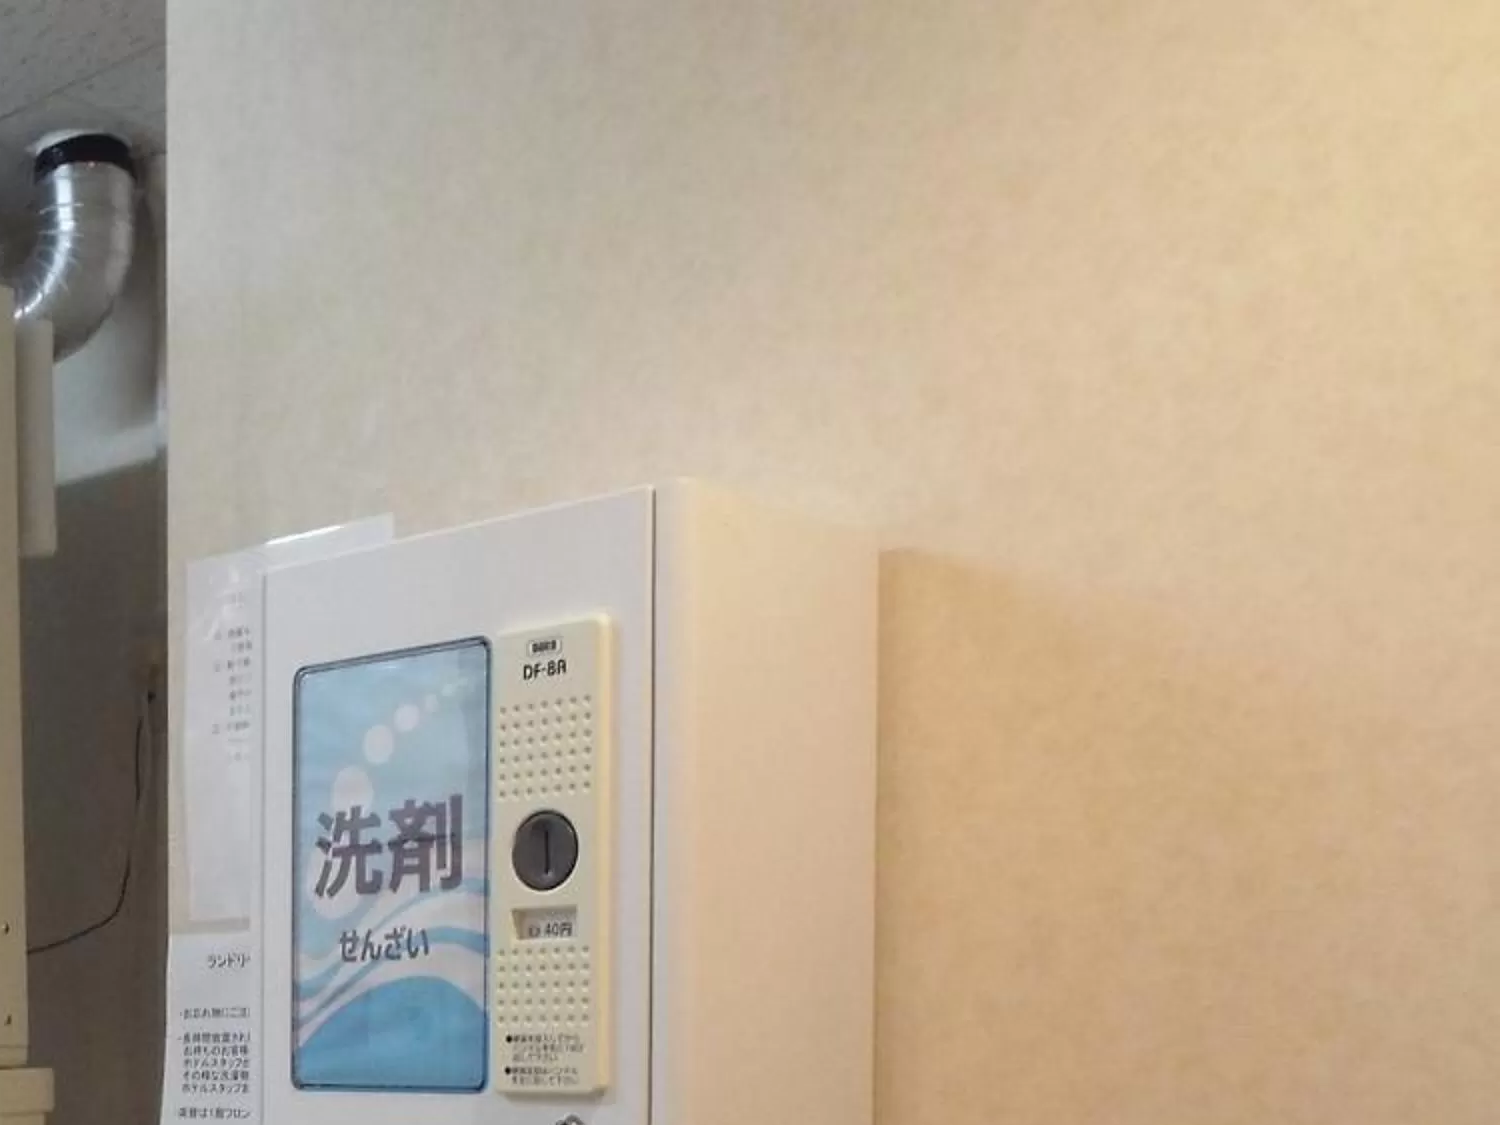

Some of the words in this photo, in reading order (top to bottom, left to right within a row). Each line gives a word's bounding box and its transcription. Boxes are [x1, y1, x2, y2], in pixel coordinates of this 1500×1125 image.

[314, 793, 464, 899] 洗剤
[207, 952, 251, 969] ランドリ
[339, 925, 430, 963] せんざい
